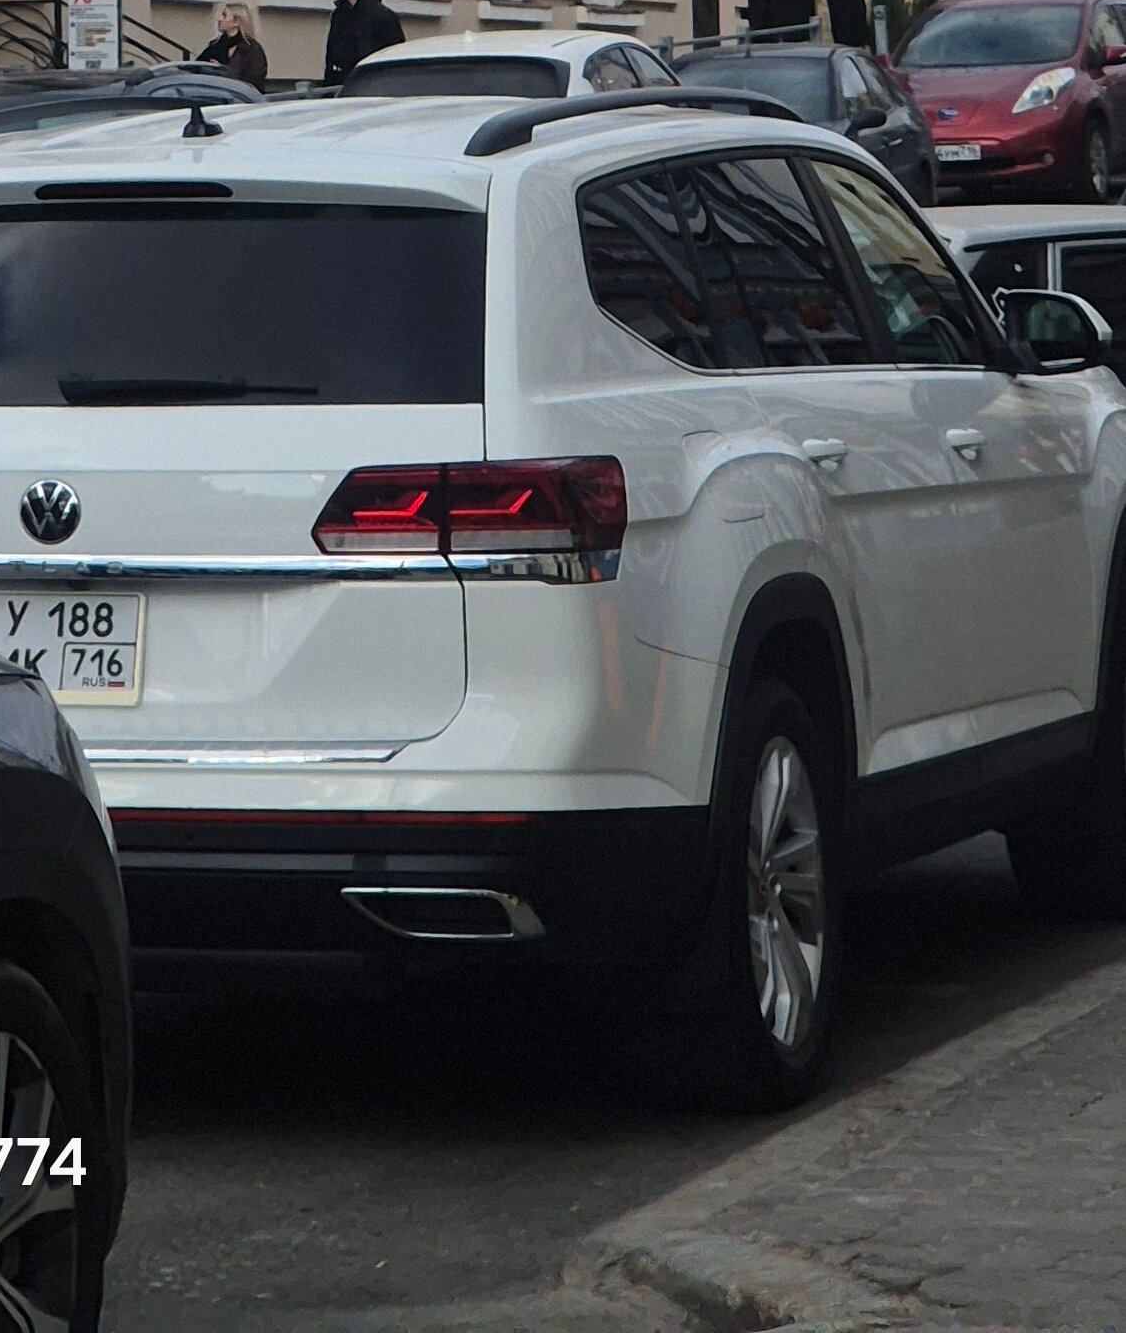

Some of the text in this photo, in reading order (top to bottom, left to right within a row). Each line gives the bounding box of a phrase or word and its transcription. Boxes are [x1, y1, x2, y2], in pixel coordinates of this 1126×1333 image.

[48, 601, 114, 638] 188
[71, 648, 123, 677] 716
[82, 677, 106, 687] RUS
